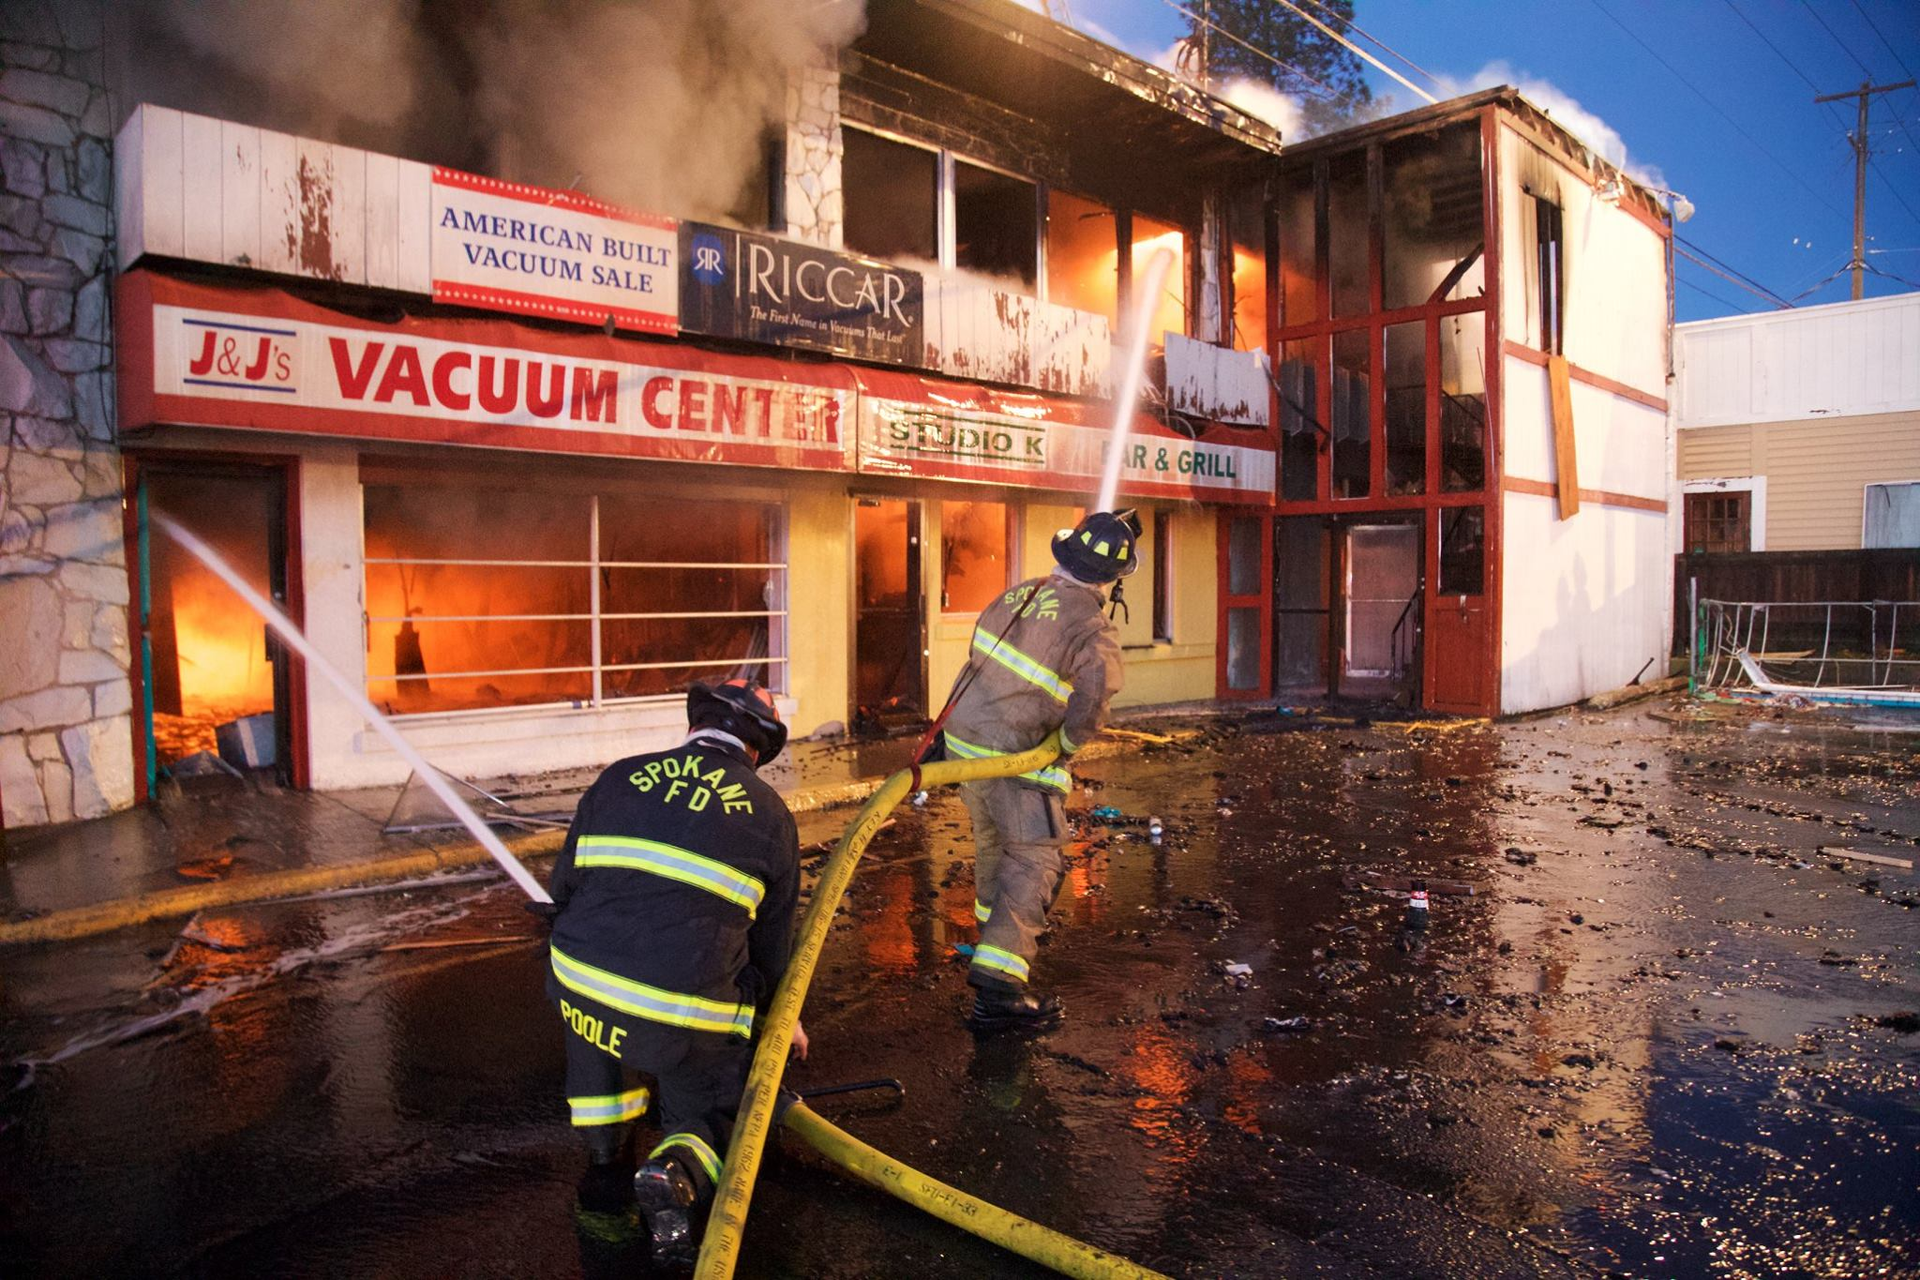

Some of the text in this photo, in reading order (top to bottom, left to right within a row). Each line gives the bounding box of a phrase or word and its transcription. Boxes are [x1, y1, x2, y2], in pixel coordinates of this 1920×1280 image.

[440, 207, 672, 268] AMERICAN BUILT
[463, 242, 654, 294] VACUUM SALE
[749, 243, 910, 328] RICCAR
[751, 305, 767, 321] The
[769, 309, 789, 326] First
[790, 313, 817, 330] Name
[819, 319, 828, 330] in
[830, 319, 865, 338] Vacuums
[867, 326, 886, 342] That
[328, 337, 618, 424] VACUUM
[641, 375, 840, 443] CENTER
[890, 420, 1044, 456] STUDIO K
[1102, 440, 1237, 479] BR & GRILL
[1005, 585, 1060, 621] SPOANE
[629, 755, 753, 815] SPOKANE
[560, 998, 628, 1059] POOLE
